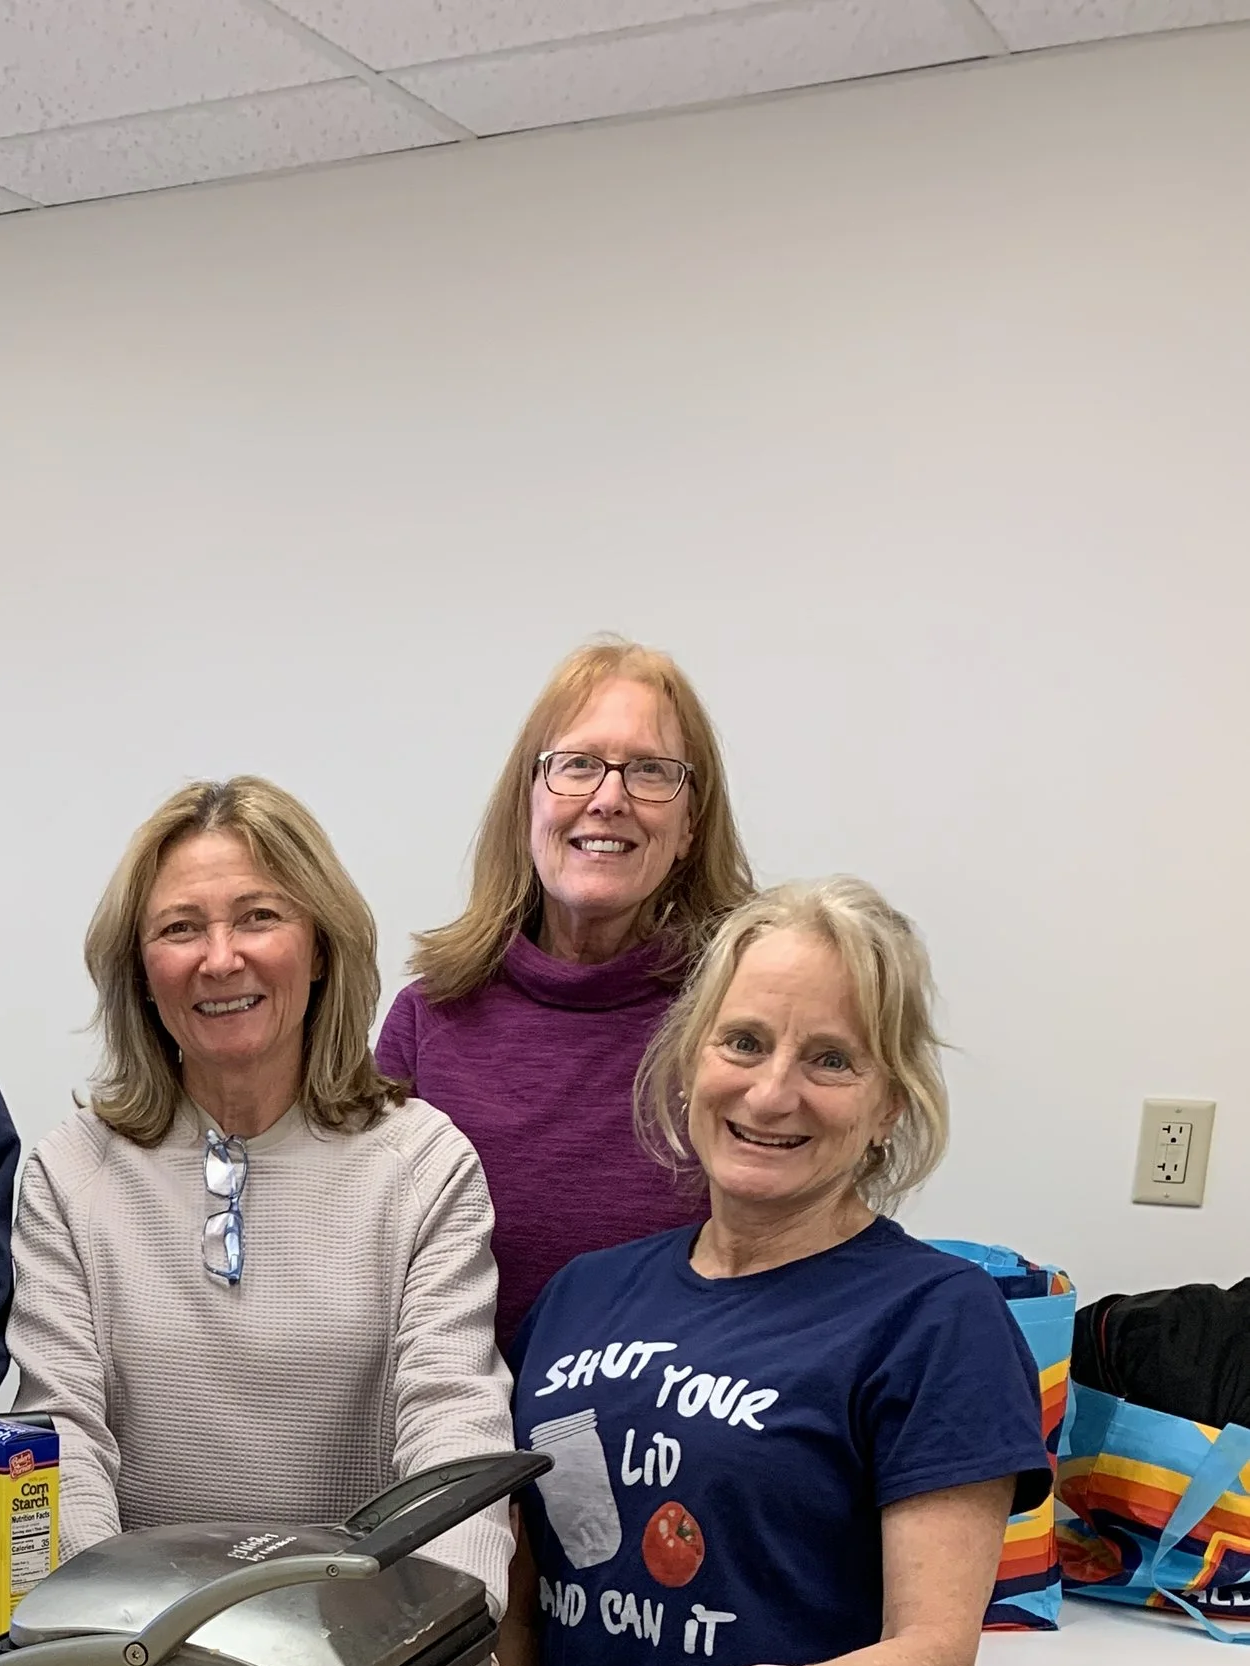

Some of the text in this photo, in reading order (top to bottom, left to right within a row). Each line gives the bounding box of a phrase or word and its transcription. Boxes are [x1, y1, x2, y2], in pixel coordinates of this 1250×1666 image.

[535, 1340, 779, 1431] SHUT YOUR
[21, 1482, 49, 1497] Corn
[12, 1493, 49, 1512] Starch
[11, 1510, 50, 1525] Nutrition Facts
[11, 1543, 35, 1553] Calories
[41, 1538, 50, 1548] 35
[539, 1576, 587, 1628] AND
[599, 1589, 664, 1647] CAN
